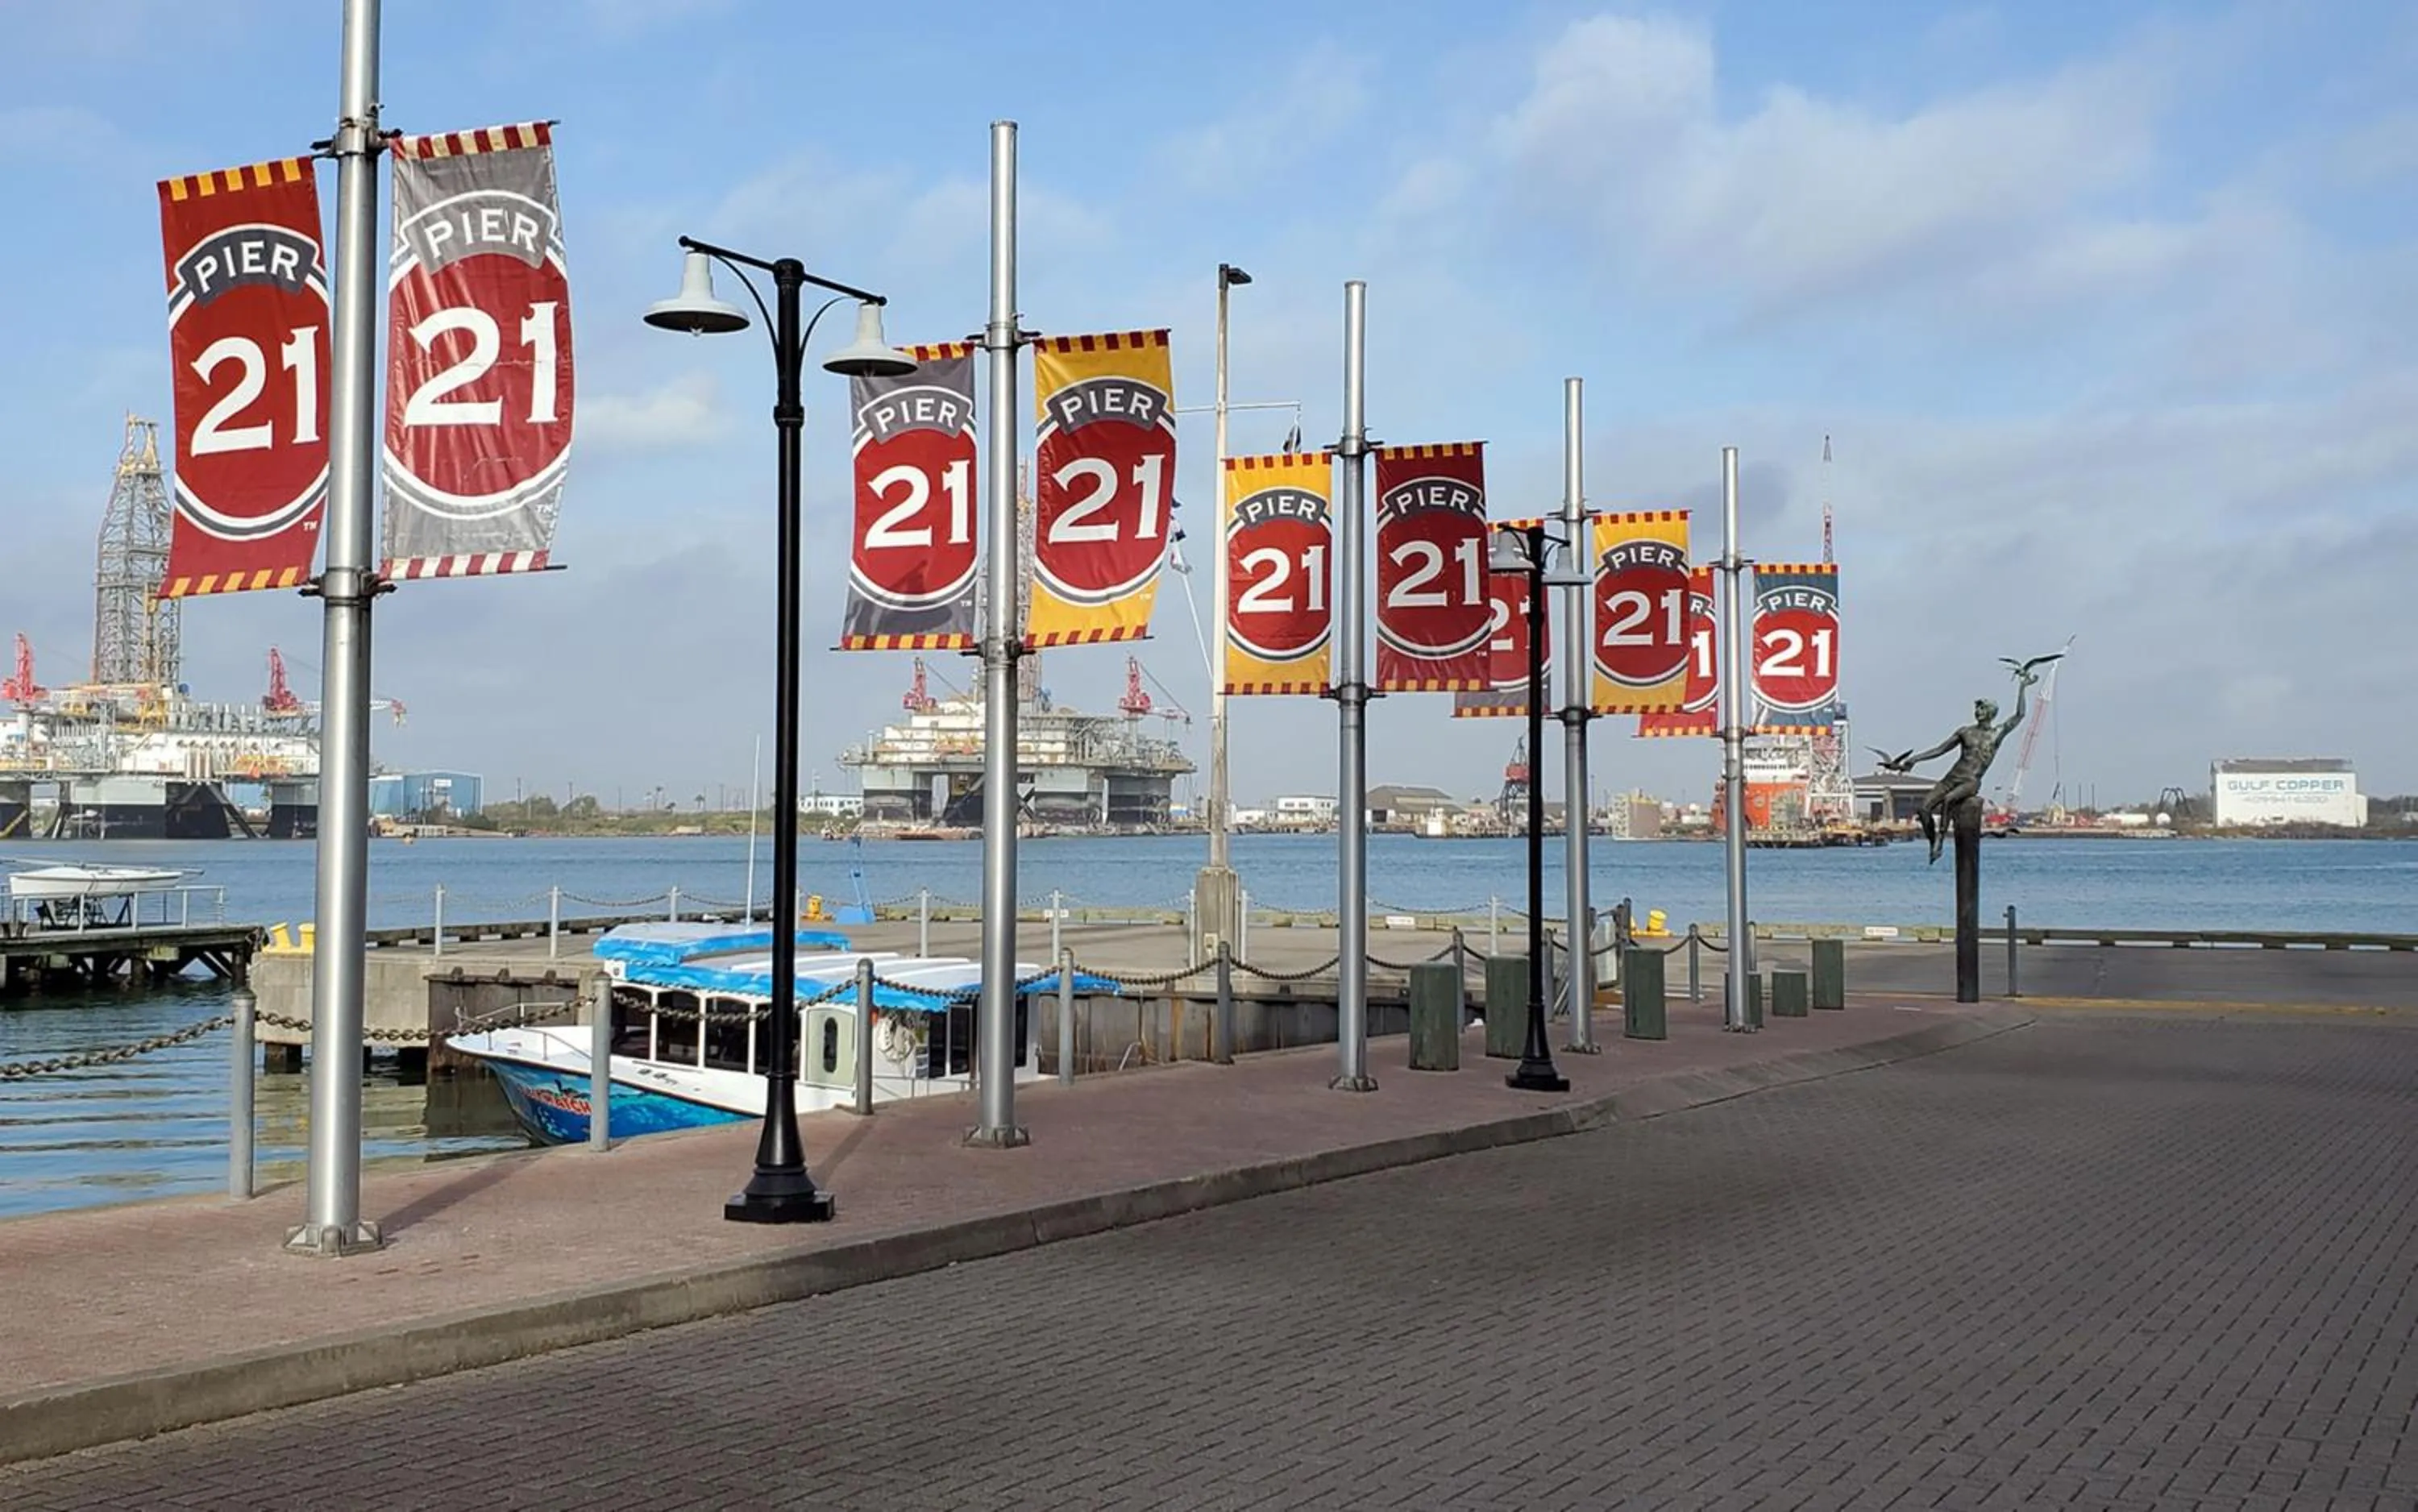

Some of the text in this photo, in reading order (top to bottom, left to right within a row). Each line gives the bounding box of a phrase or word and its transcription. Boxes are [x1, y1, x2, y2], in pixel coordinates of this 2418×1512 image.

[425, 208, 539, 258] PIER
[193, 241, 299, 292] PIER
[403, 300, 559, 428] 21
[190, 325, 320, 457] 21
[875, 398, 958, 434] PIER
[1060, 388, 1154, 425] PIER
[865, 459, 970, 550] 21
[1049, 454, 1165, 545] 21
[1245, 496, 1318, 523] PIER
[1396, 486, 1469, 514] PIER
[1237, 544, 1326, 614] 21
[1387, 538, 1483, 609] 21
[1611, 545, 1675, 569] PIER
[1602, 588, 1683, 646] 21
[1768, 592, 1826, 612] PIER
[1759, 629, 1834, 678] 21
[2227, 779, 2345, 791] GULF COPPER
